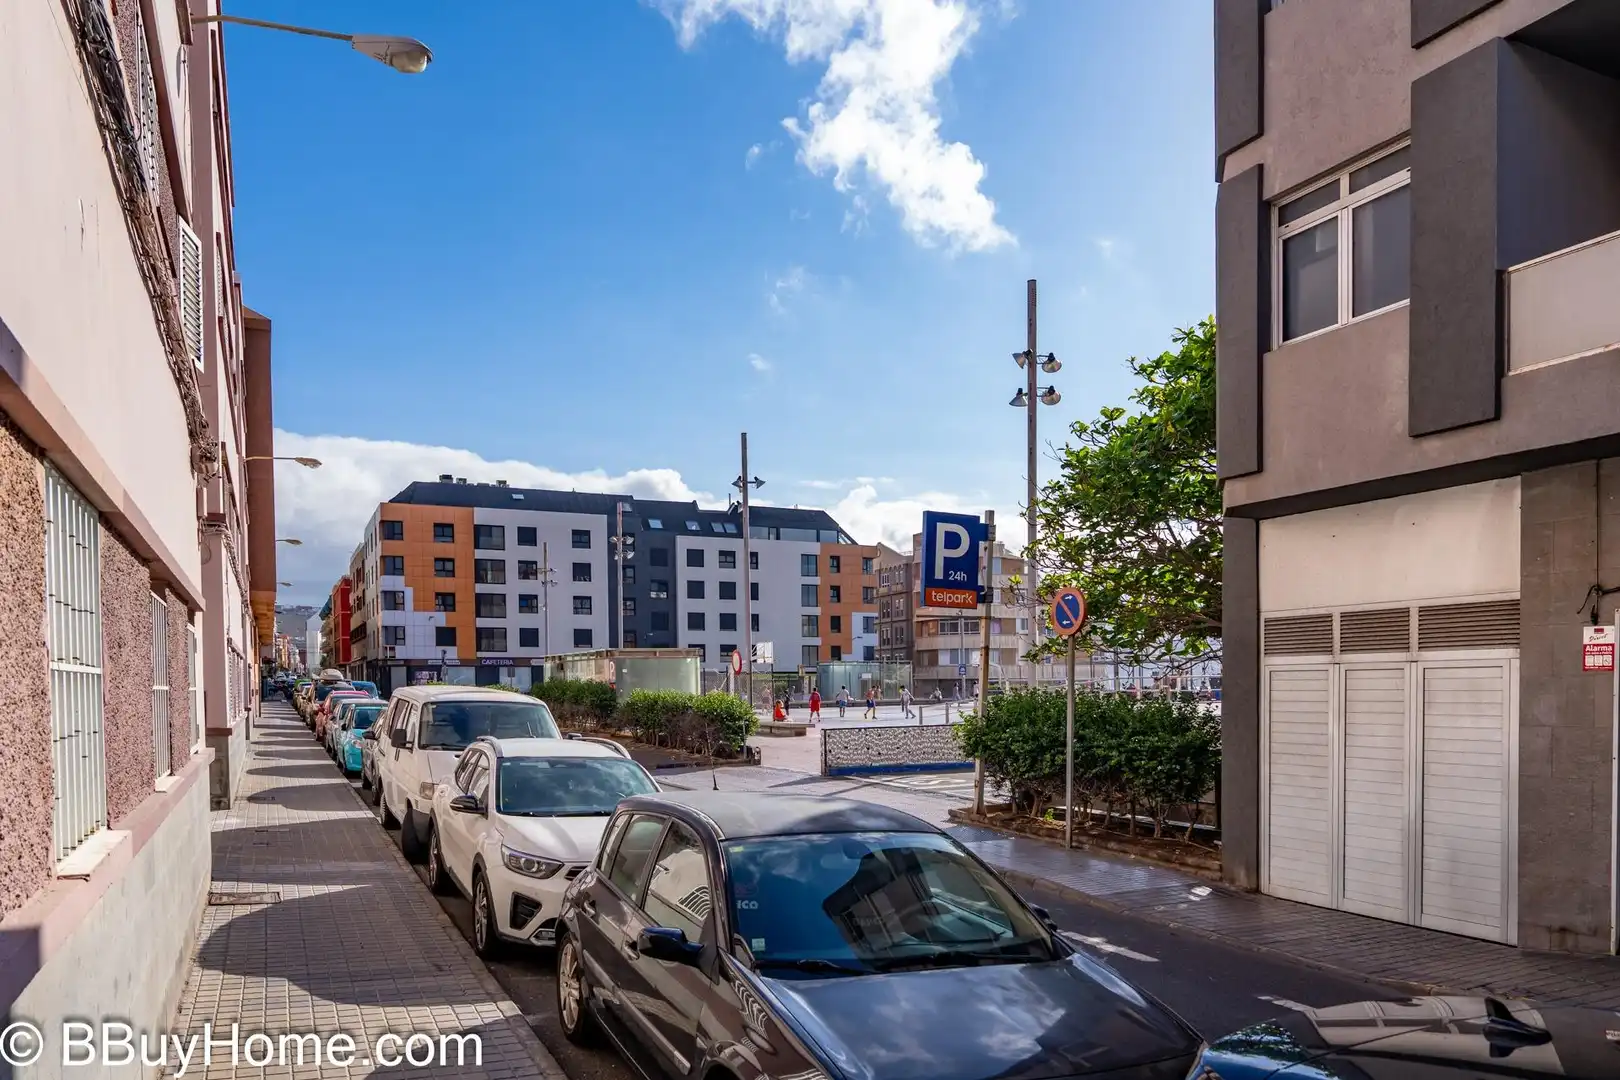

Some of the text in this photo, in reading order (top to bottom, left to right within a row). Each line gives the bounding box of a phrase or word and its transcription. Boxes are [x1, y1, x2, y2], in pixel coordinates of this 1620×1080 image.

[935, 522, 970, 579] P
[949, 571, 967, 581] 24h
[931, 590, 973, 605] telpark
